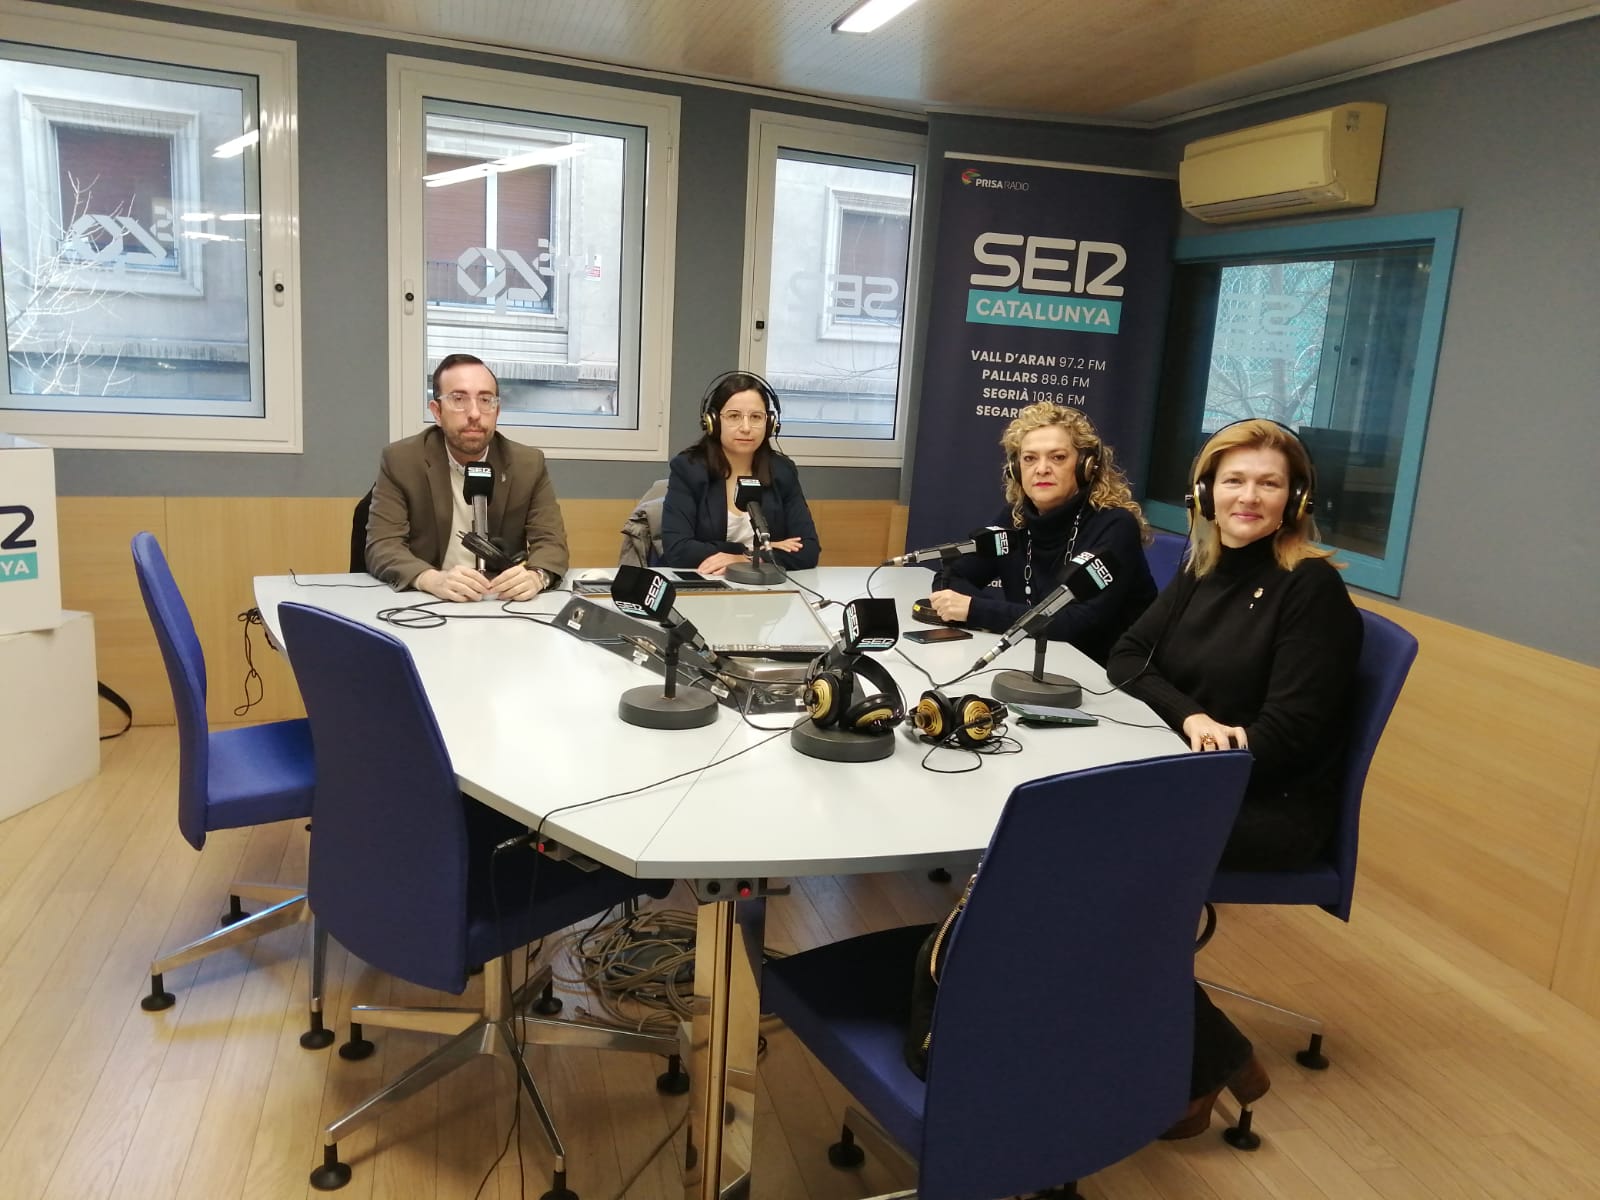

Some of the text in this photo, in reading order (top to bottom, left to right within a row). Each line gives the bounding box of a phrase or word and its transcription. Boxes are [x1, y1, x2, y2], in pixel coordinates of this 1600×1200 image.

[975, 178, 1030, 191] PRISA RADIO
[969, 232, 1128, 297] SER
[975, 298, 1112, 327] CATALUNYA
[970, 349, 1002, 363] VALL
[1059, 356, 1085, 369] 97.2
[1088, 359, 1106, 371] FM
[982, 369, 1090, 388] PALLARS 89.6 FM
[982, 387, 1085, 406] SEGRIÀ 103.6 FM
[975, 404, 1022, 419] SEGAR
[999, 531, 1009, 555] SER
[1091, 558, 1114, 586] SER
[644, 575, 664, 609] SER
